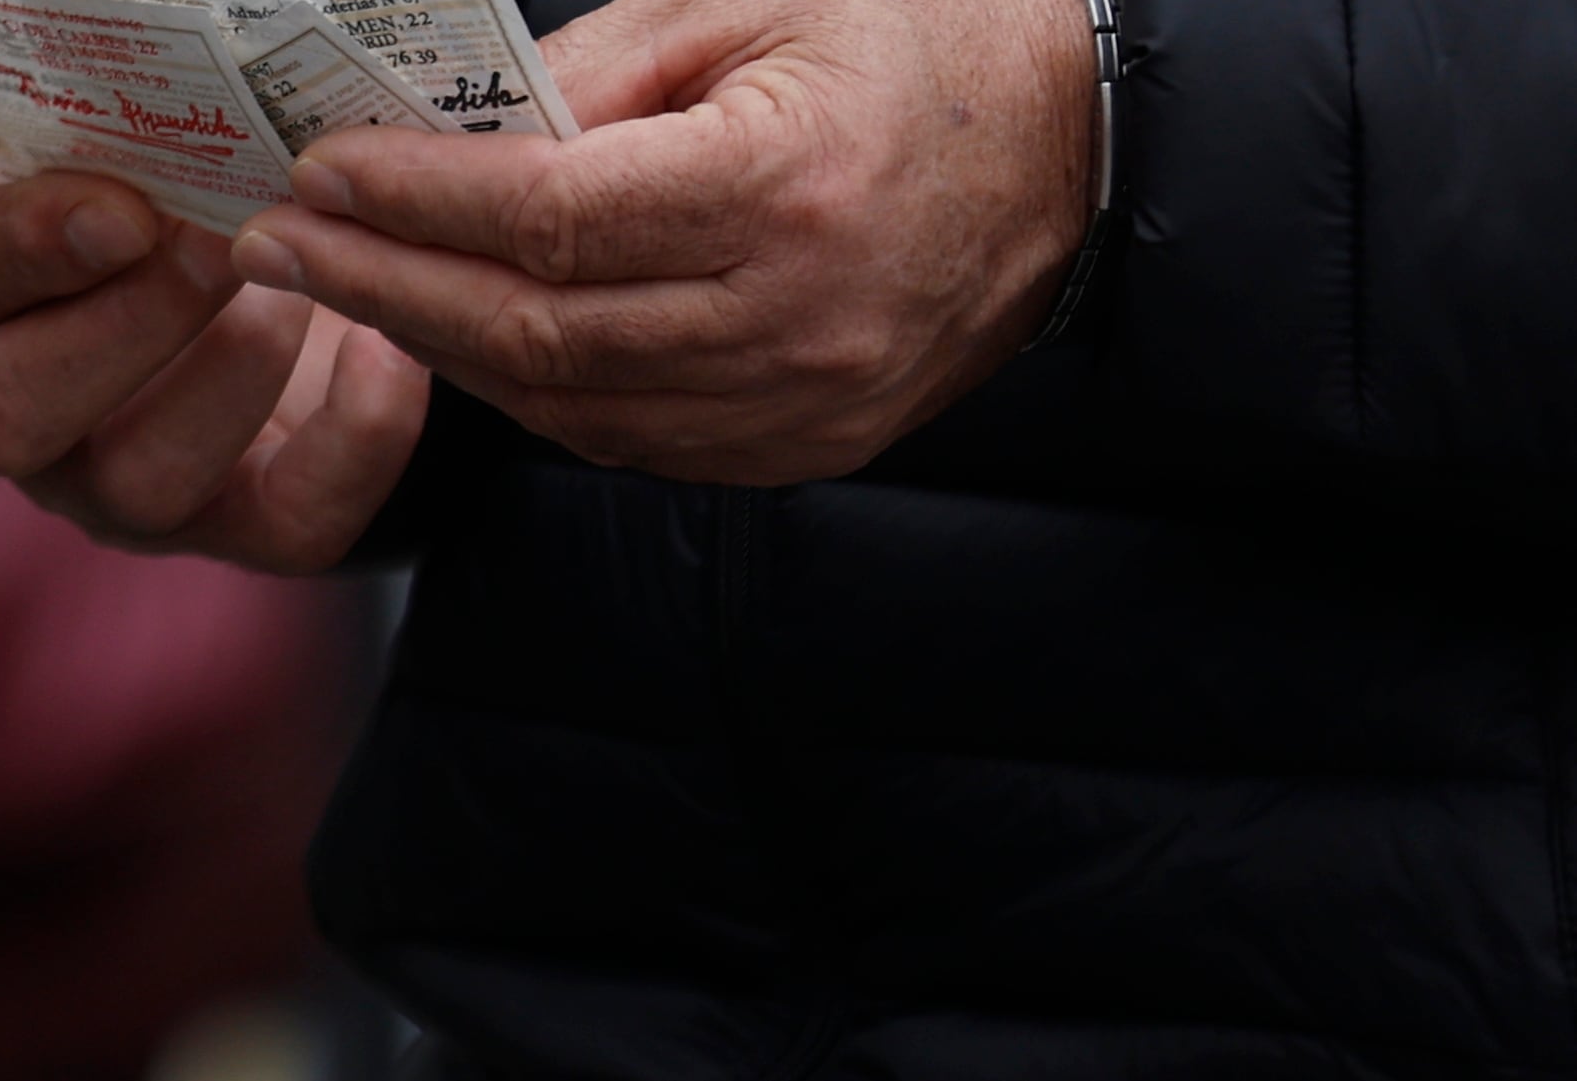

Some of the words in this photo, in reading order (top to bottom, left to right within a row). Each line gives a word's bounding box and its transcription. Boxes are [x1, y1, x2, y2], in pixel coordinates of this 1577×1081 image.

[337, 15, 404, 36] MEN,
[405, 11, 433, 27] 22
[135, 39, 159, 56] 22
[387, 51, 412, 68] 76
[415, 49, 438, 65] 39
[274, 80, 298, 98] 22
